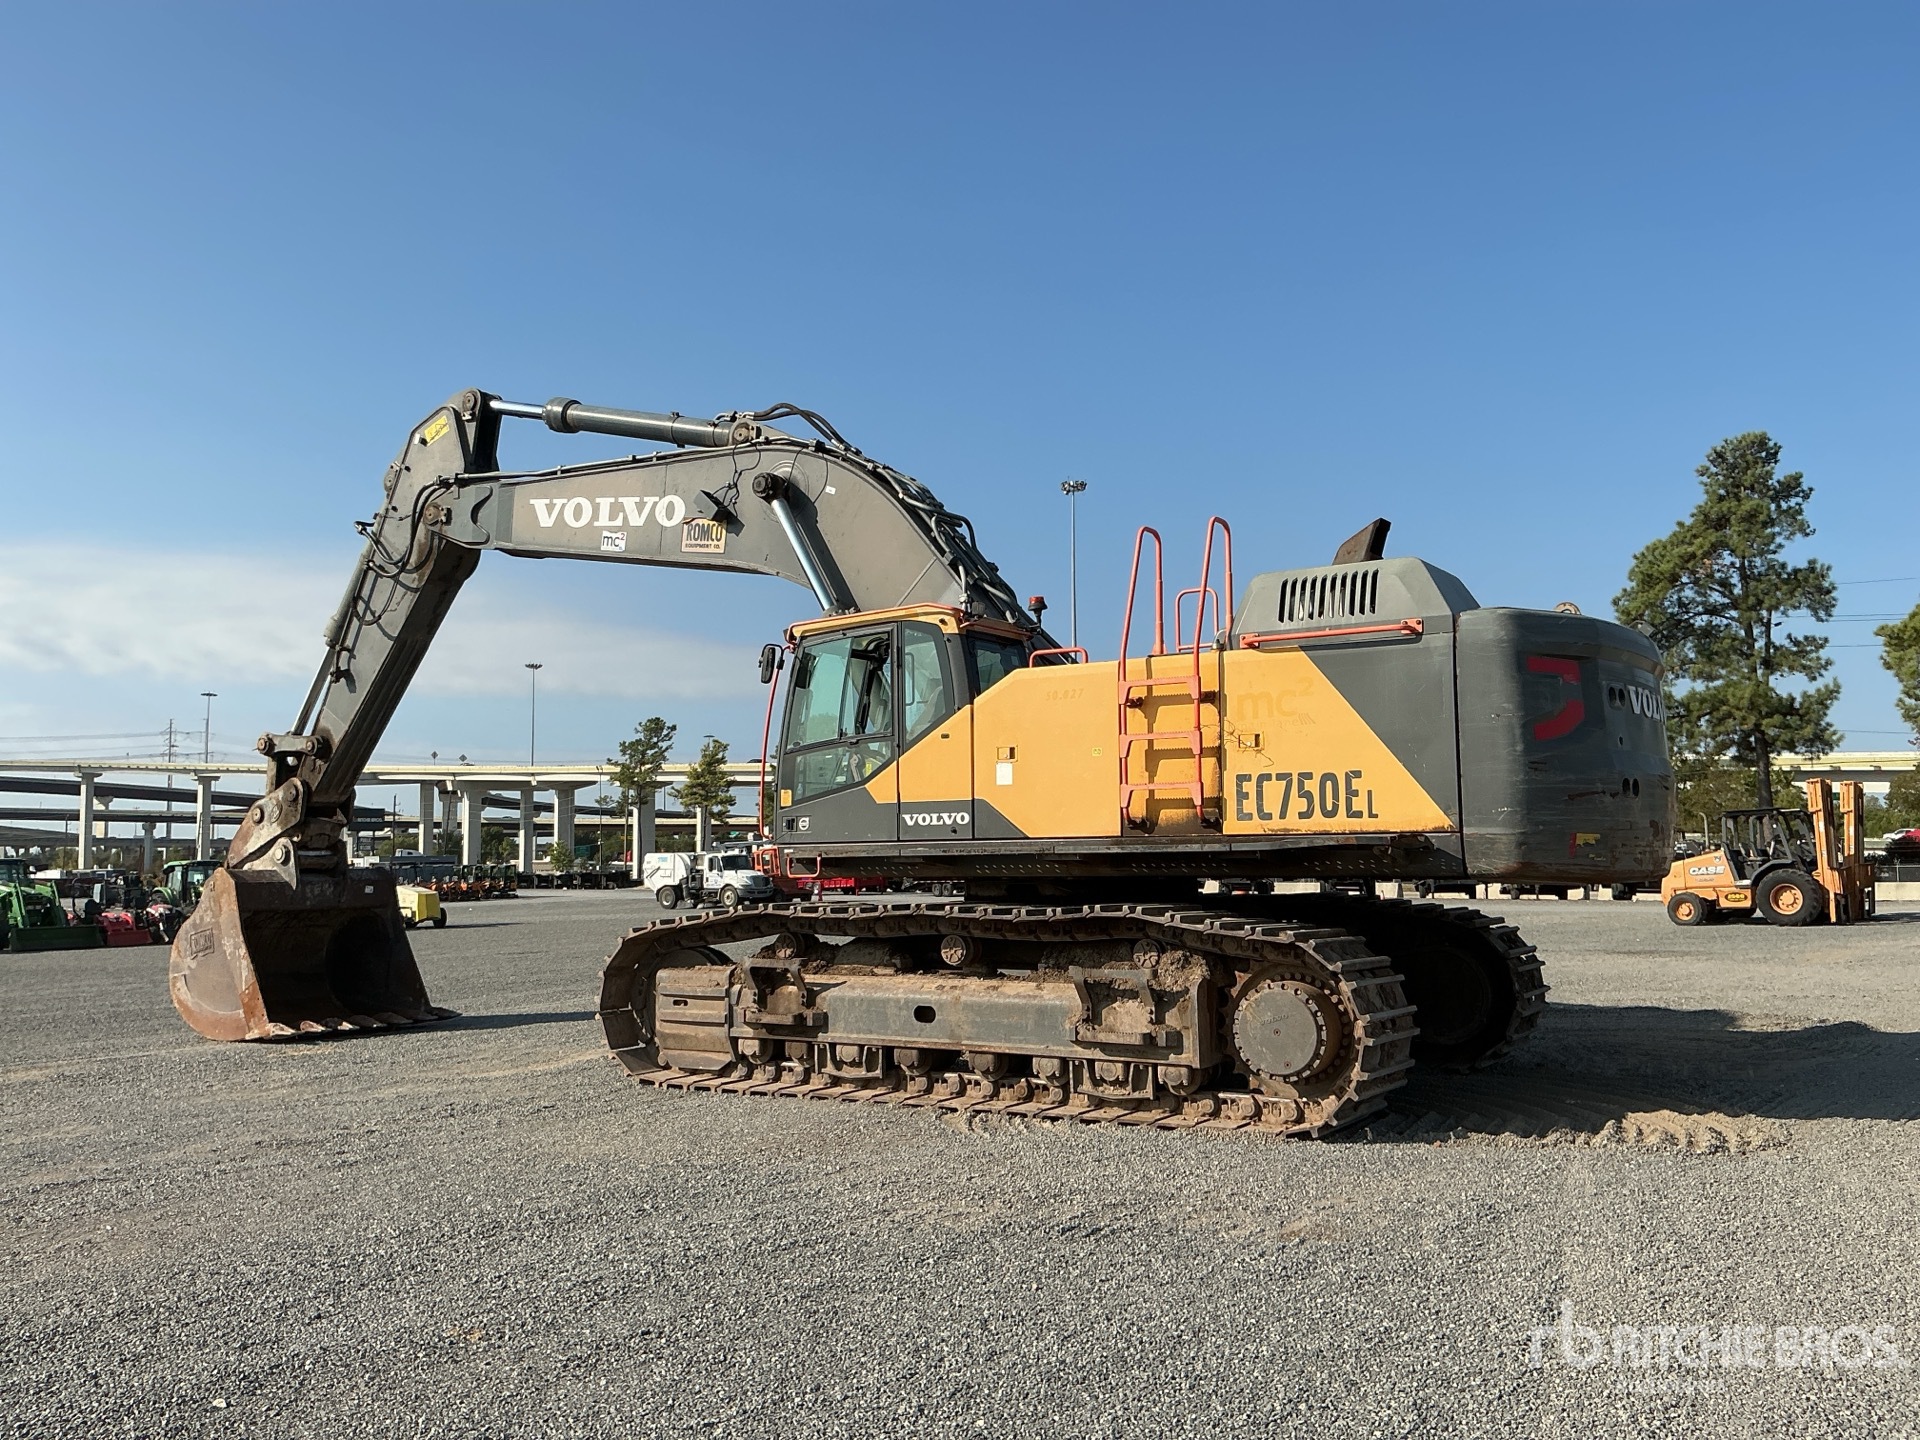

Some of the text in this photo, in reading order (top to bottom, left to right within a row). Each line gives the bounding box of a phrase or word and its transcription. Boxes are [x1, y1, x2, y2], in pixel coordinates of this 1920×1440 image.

[530, 494, 686, 528] VOLVO
[686, 522, 723, 542] ROMCO
[902, 811, 970, 827] VOLVO
[1689, 865, 1726, 876] CASE
